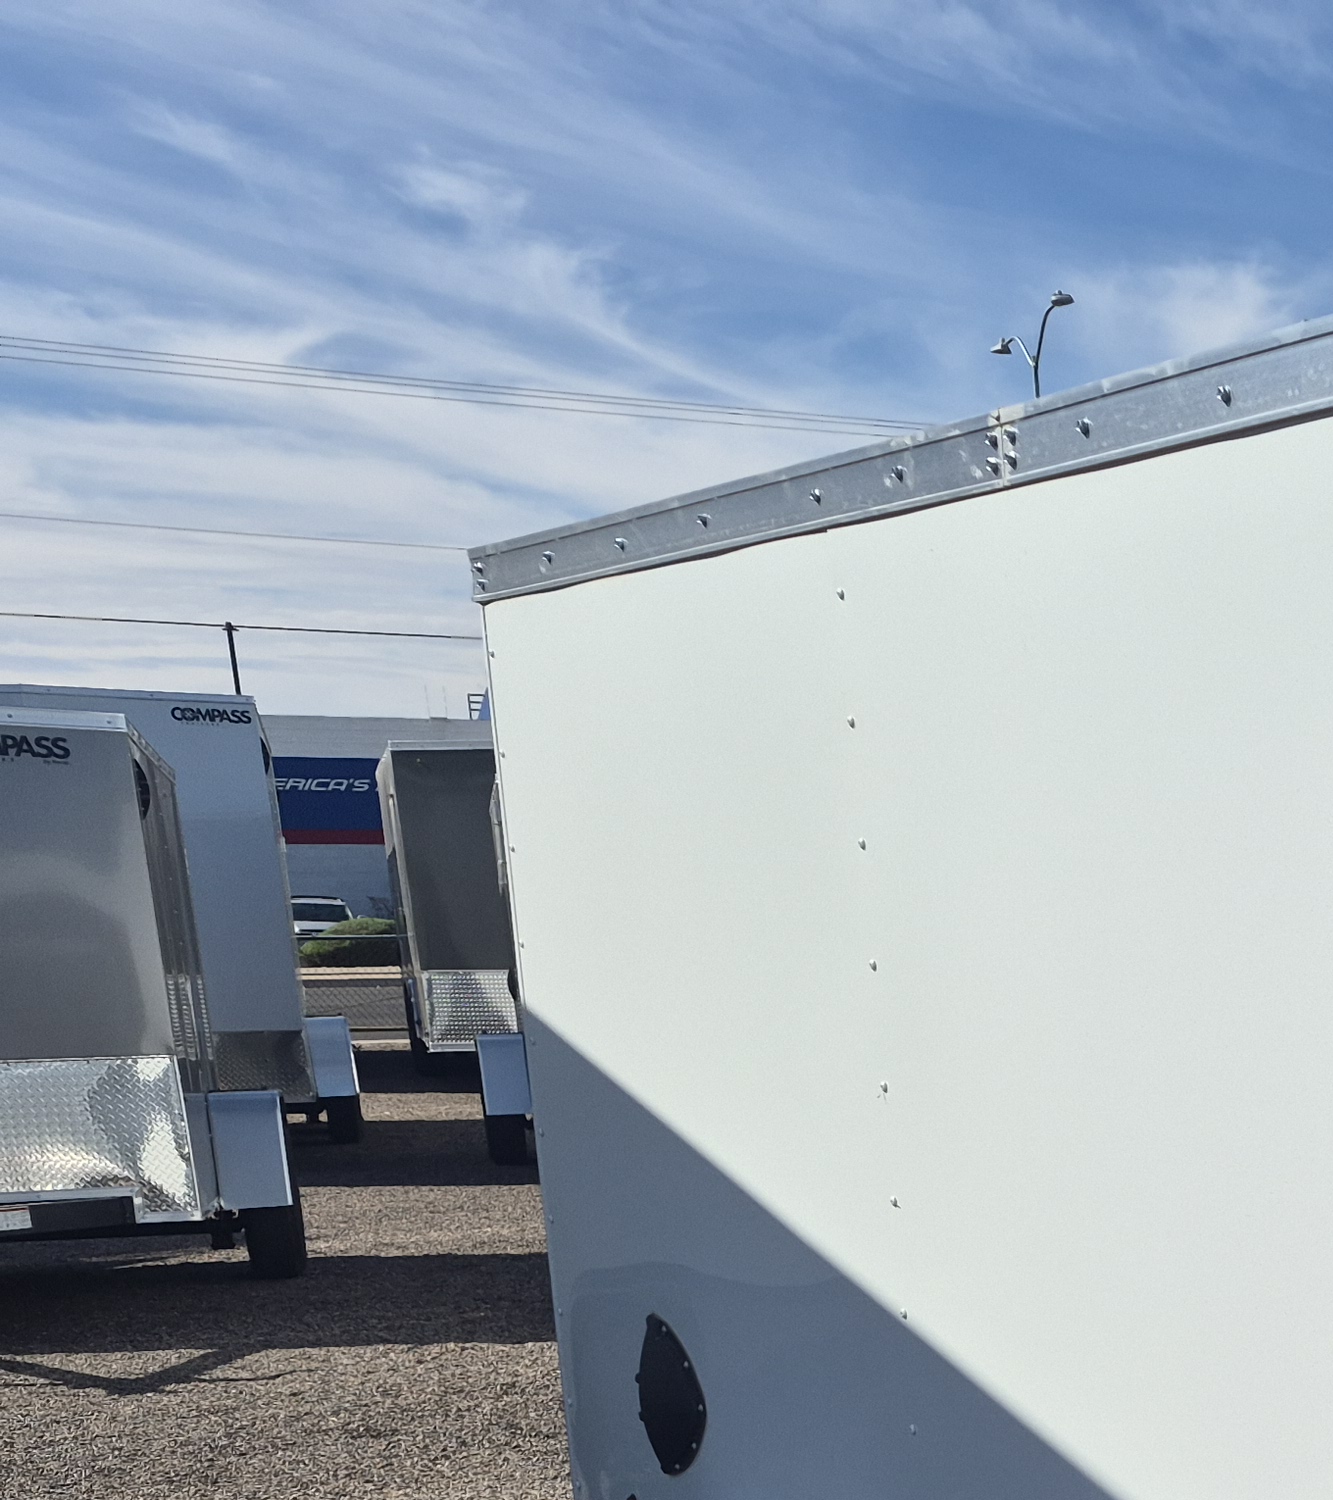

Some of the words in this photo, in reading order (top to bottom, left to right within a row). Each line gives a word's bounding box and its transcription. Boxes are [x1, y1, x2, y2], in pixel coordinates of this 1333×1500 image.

[170, 706, 252, 724] COMPASS
[0, 734, 70, 759] PASS
[275, 778, 370, 791] ERICA'S
